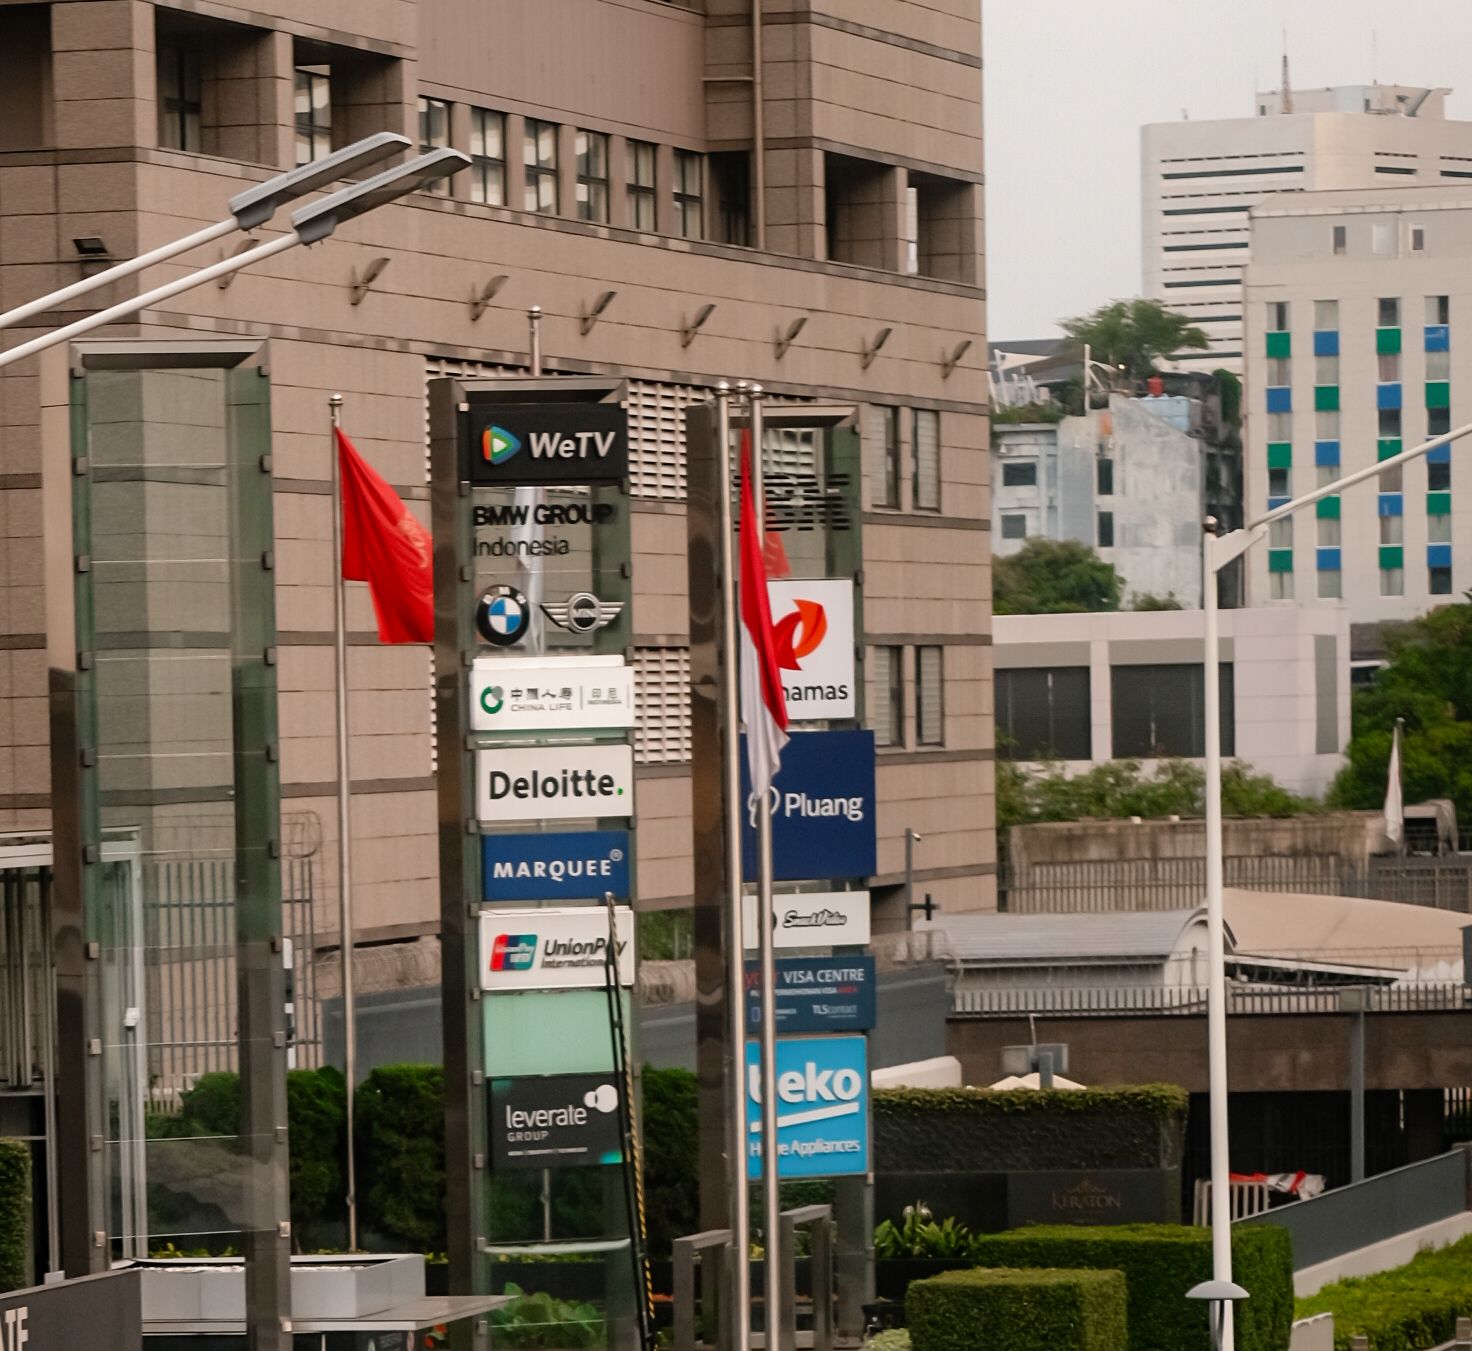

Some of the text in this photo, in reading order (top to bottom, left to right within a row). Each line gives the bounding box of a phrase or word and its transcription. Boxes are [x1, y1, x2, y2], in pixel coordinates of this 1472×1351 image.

[529, 431, 616, 459] WeTV
[473, 504, 613, 527] BMW GROUP
[473, 537, 570, 557] Indonesia
[489, 769, 624, 800] Deloitte.
[785, 793, 864, 821] Pluang
[543, 938, 628, 957] UnionPy
[783, 970, 814, 983] VISA
[816, 968, 865, 982] CENTRE
[505, 1104, 588, 1129] leverate
[507, 1130, 549, 1142] GROUP
[790, 1138, 861, 1158] Appliances
